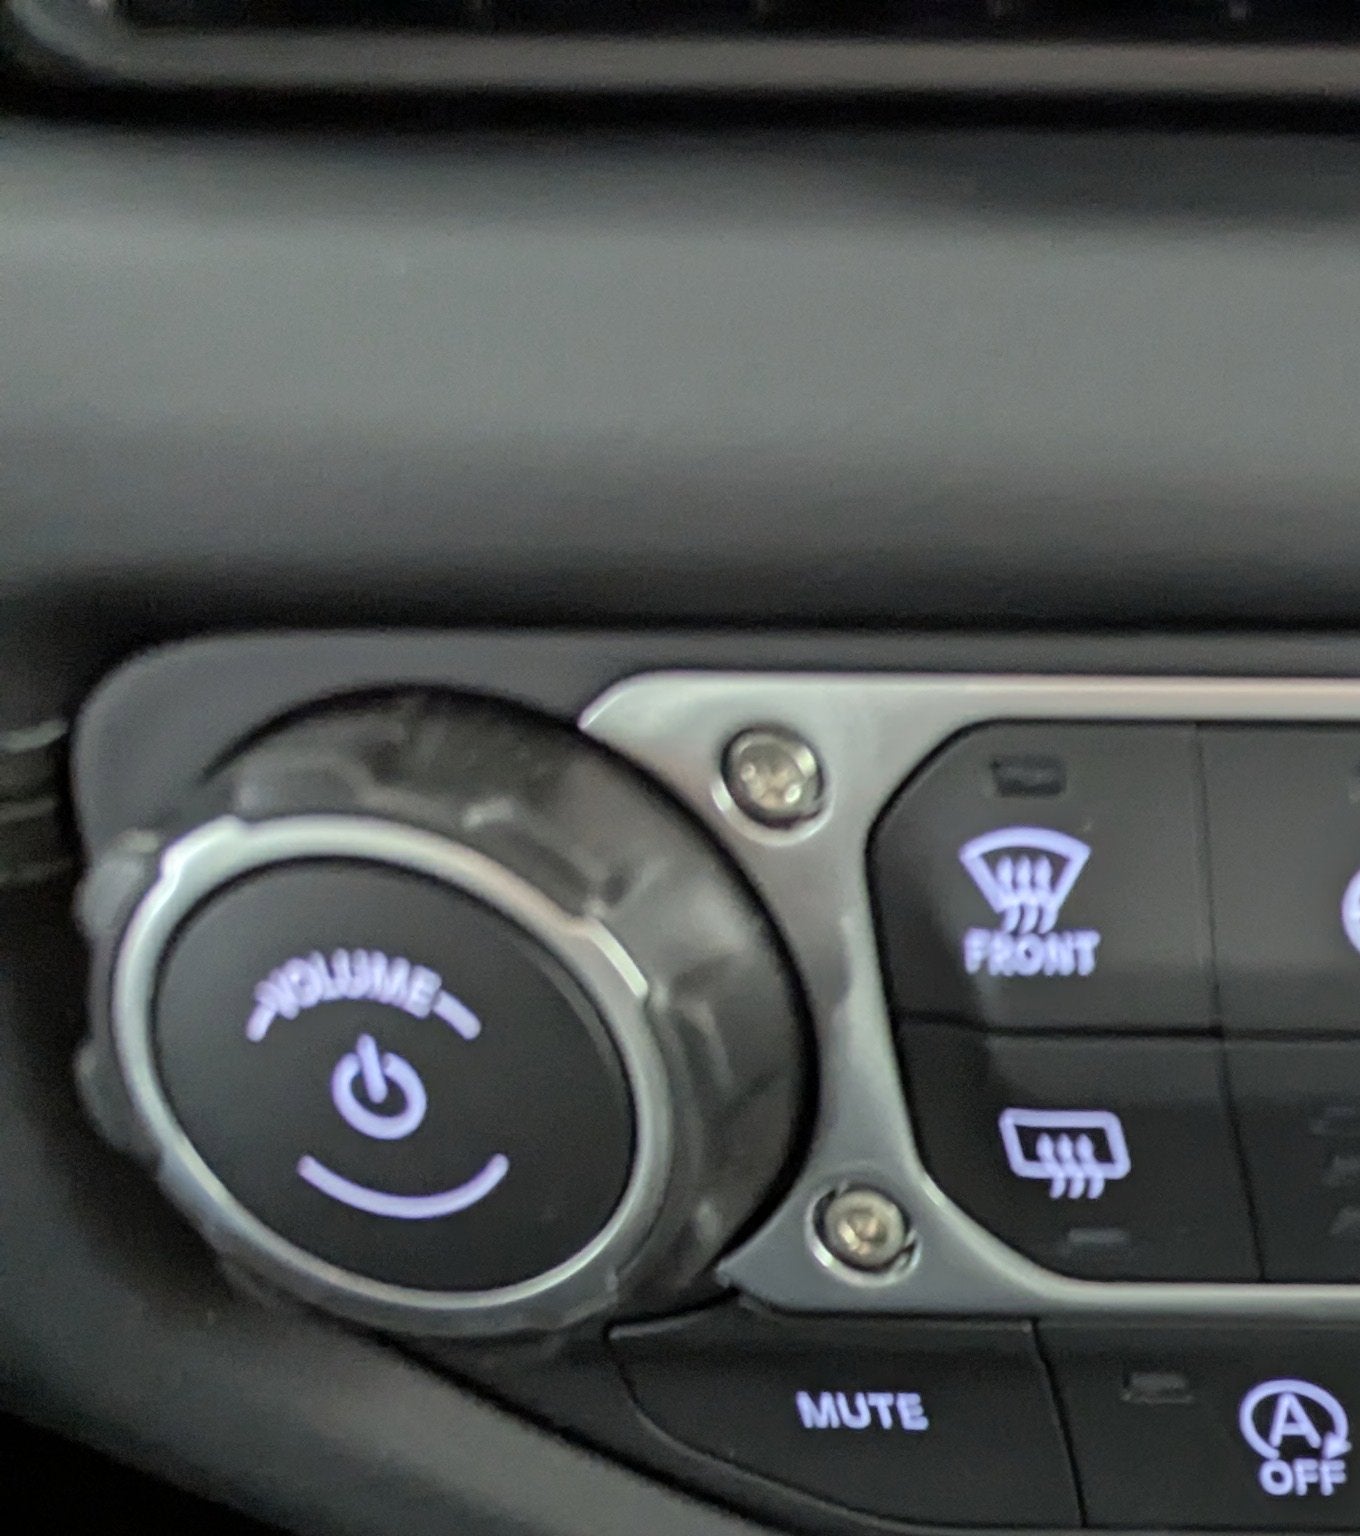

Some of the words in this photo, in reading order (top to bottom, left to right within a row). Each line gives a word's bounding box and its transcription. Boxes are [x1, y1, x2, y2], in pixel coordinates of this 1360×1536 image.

[963, 929, 1101, 977] FRONT
[254, 948, 442, 1020] VOLUME
[795, 1391, 929, 1431] MUTE
[1258, 1458, 1346, 1496] OFF
